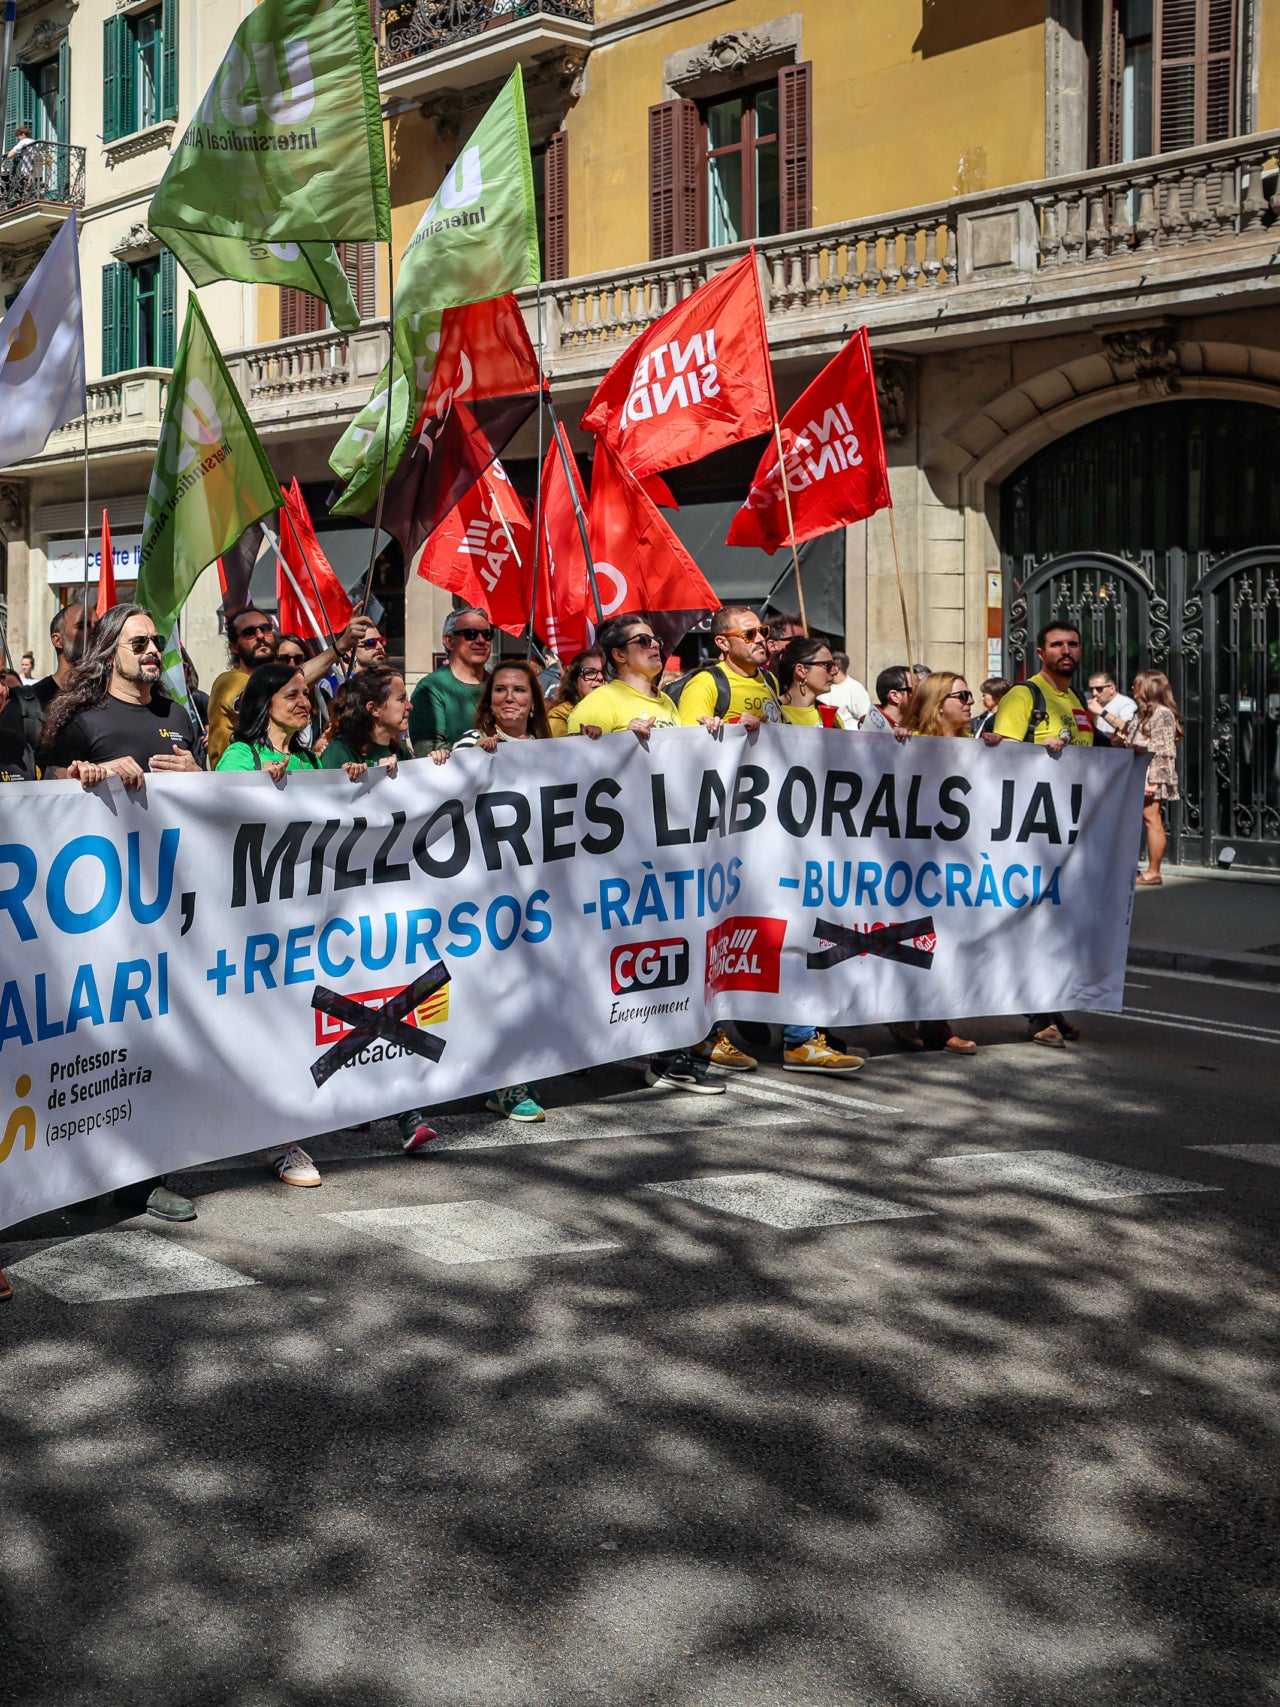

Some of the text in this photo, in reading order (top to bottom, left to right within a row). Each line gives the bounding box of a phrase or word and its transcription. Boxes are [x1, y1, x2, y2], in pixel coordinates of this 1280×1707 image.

[230, 777, 625, 908] MILLORES
[651, 764, 972, 848] LABORALS
[991, 779, 1084, 845] JA!
[206, 889, 553, 997] +RECURSOS
[583, 855, 744, 931] -RÀTIOS
[778, 851, 1062, 909] -BUROCRÀCIA
[614, 944, 685, 989] CGT
[608, 996, 690, 1025] Ensenyament
[47, 1065, 153, 1111] de Secundària
[49, 1047, 128, 1084] Professors
[45, 1098, 132, 1148] (aspepc·sps)
